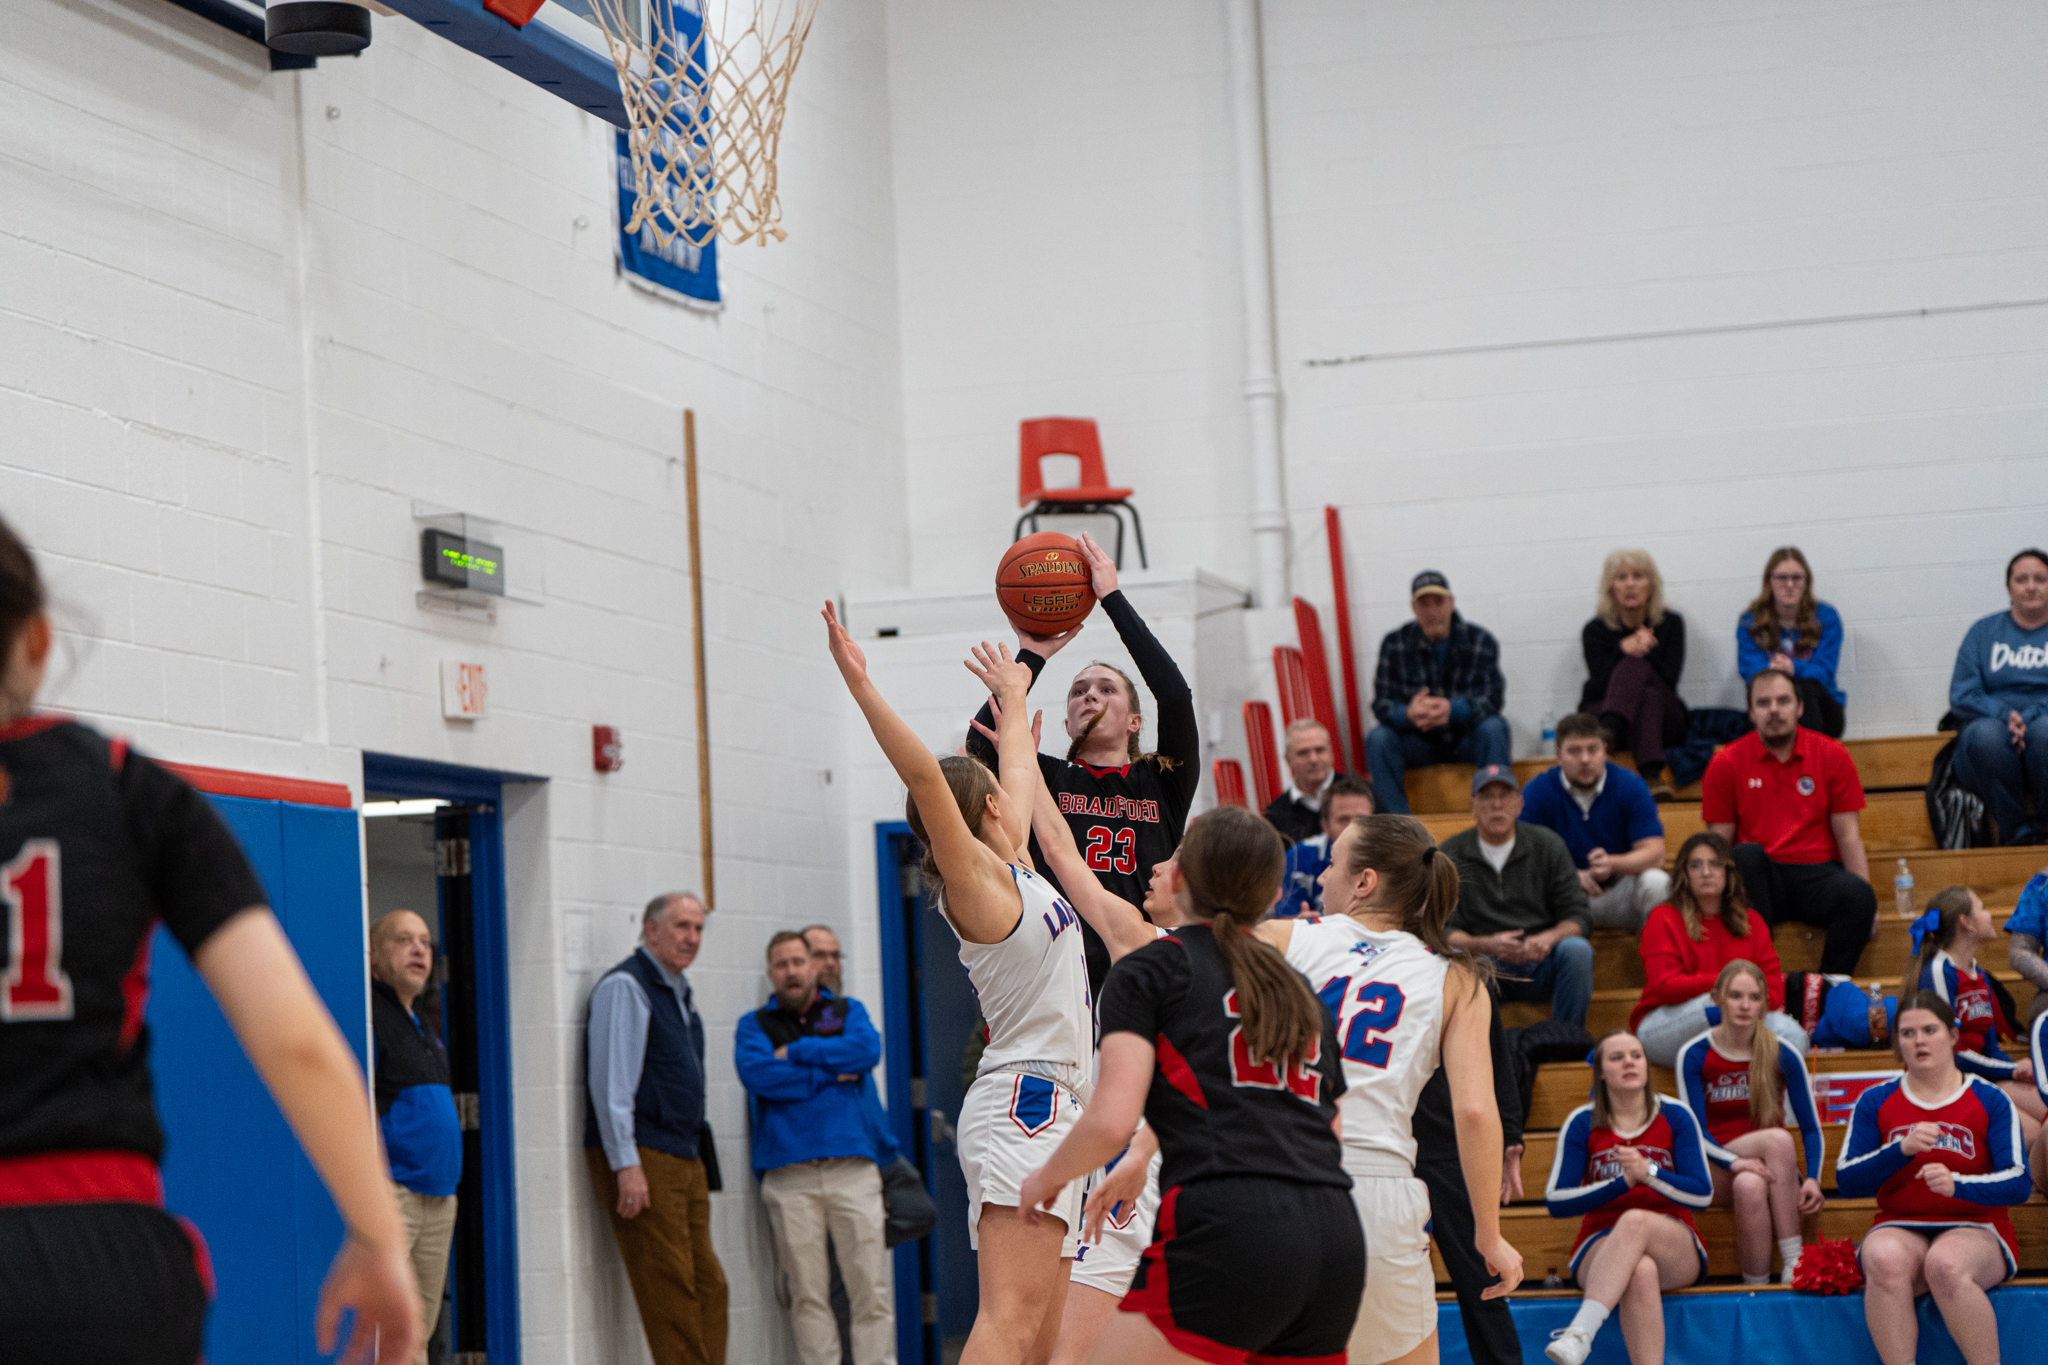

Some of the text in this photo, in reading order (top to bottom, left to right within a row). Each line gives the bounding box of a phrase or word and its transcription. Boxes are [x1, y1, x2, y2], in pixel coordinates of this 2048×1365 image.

[1019, 561, 1086, 580] SPALDING
[1022, 590, 1084, 606] LEGACY
[1085, 825, 1137, 875] 23
